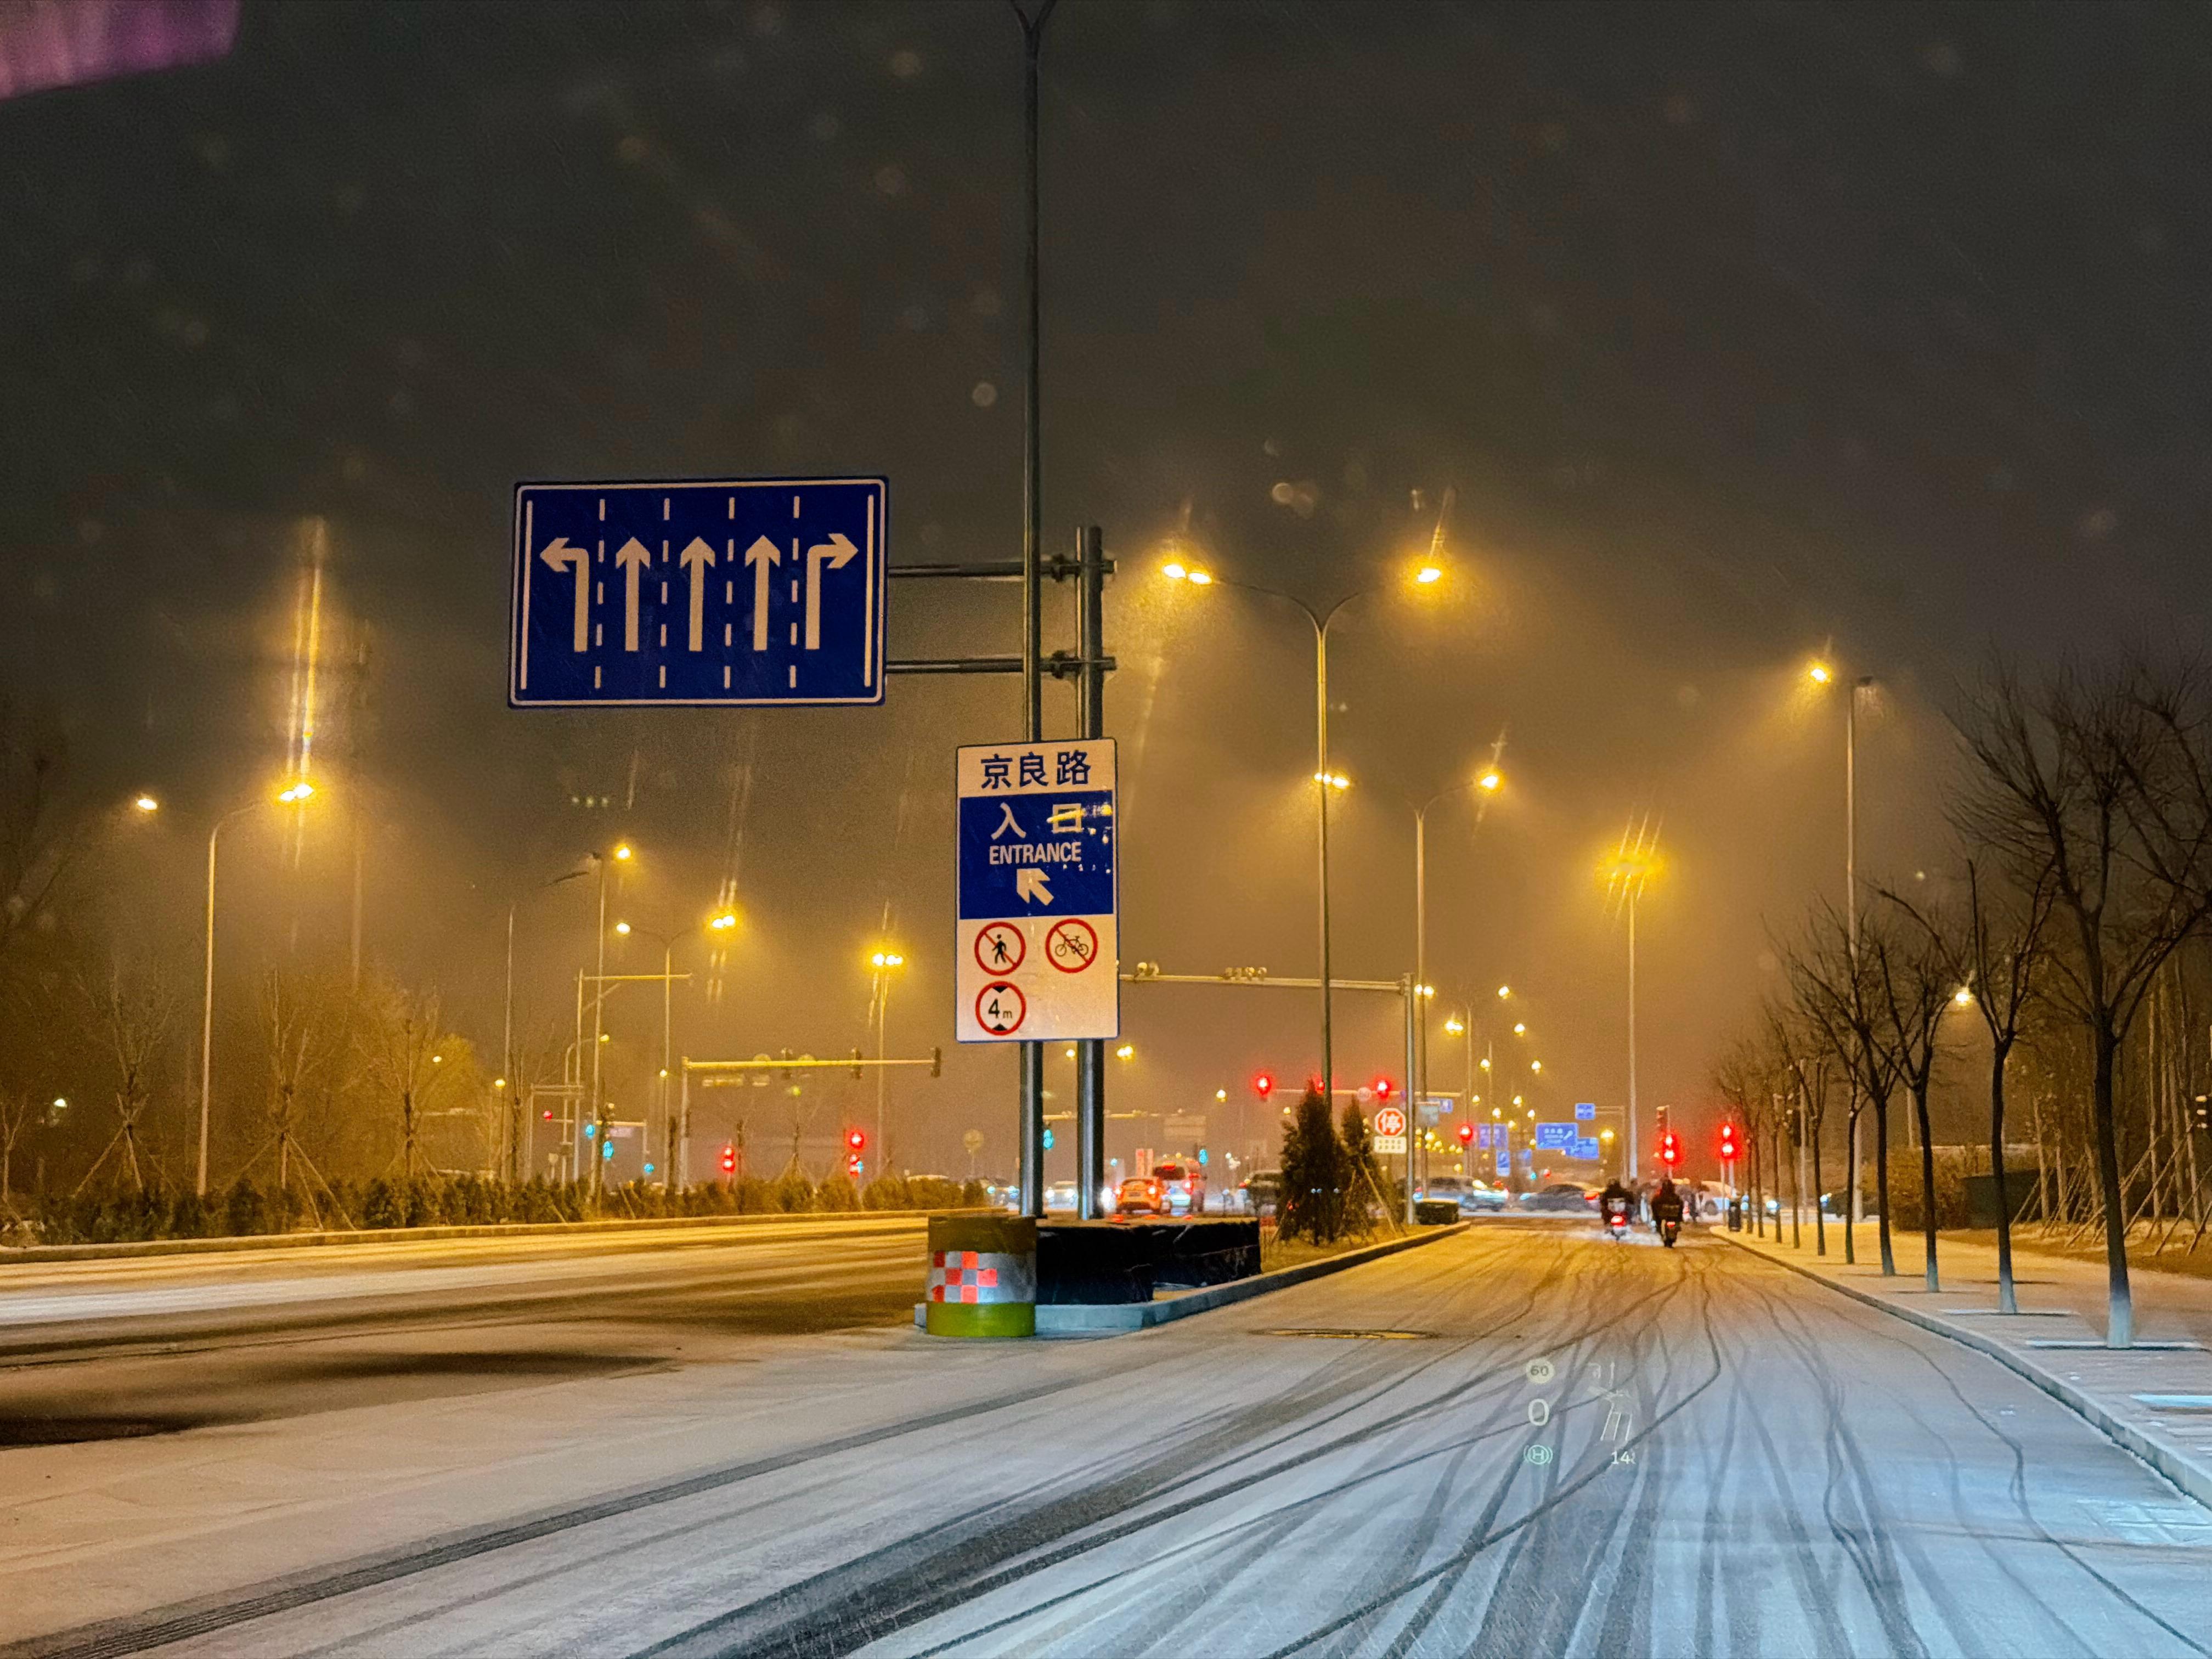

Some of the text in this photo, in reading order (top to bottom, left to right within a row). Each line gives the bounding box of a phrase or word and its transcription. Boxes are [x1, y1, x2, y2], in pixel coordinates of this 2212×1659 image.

[981, 750, 1091, 789] 京良路
[991, 803, 1082, 839] 入口
[989, 842, 1082, 865] ENTRANCE
[1380, 1113, 1401, 1133] 停
[1530, 1365, 1549, 1376] 60
[1528, 1399, 1549, 1426] 0
